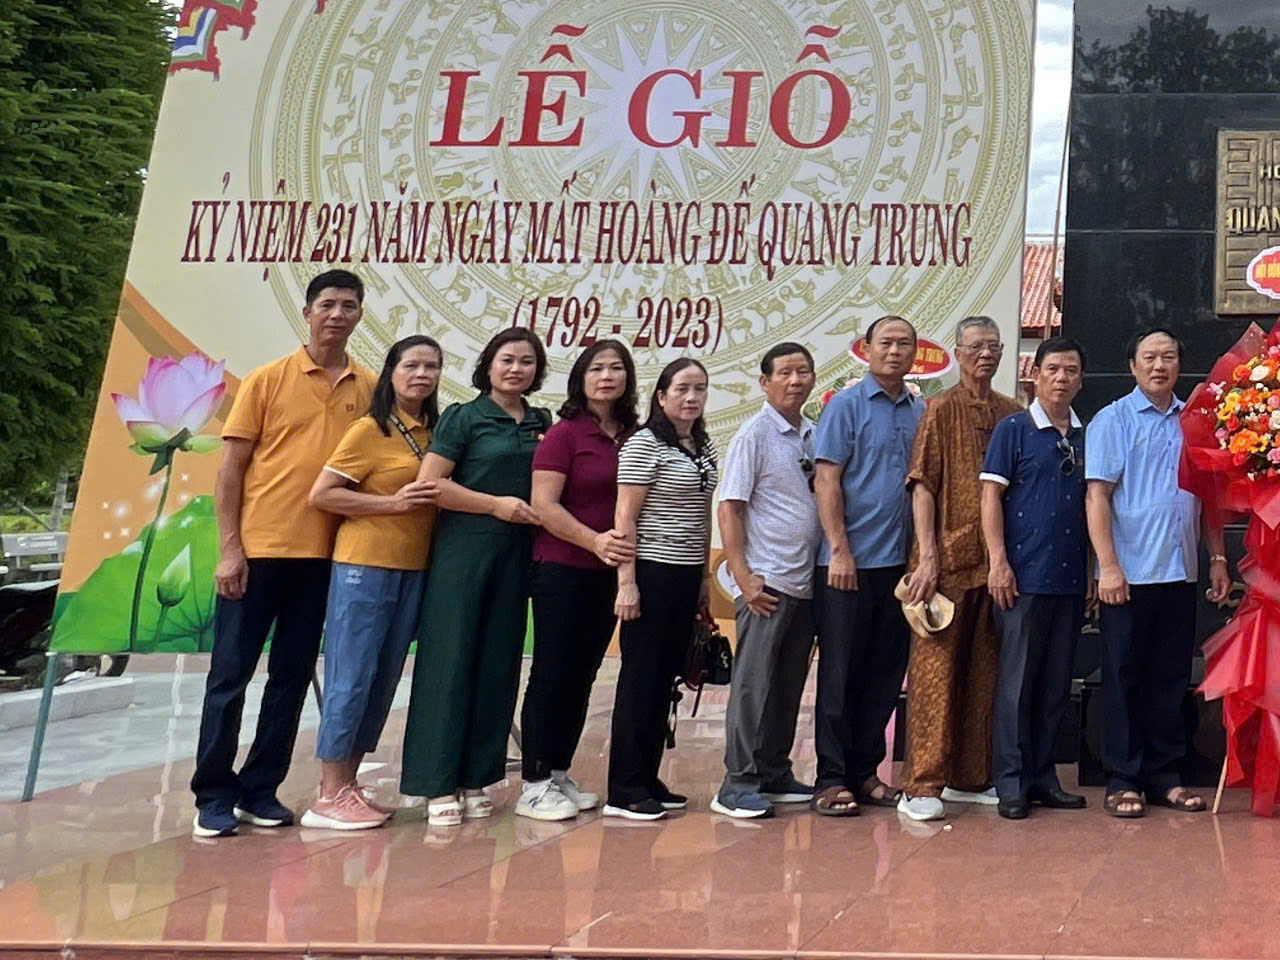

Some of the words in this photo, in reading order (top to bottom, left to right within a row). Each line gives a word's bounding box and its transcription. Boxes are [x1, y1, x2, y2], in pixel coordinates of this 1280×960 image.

[430, 24, 589, 148] LỄ
[628, 25, 852, 150] GIỖ
[180, 172, 231, 262] KỶ
[226, 179, 312, 281] NIỆM
[310, 203, 358, 263] 231
[361, 181, 434, 264] NĂM
[434, 179, 522, 265] NGÀY
[522, 170, 591, 263] MẤT
[593, 179, 701, 265] HOÀNG
[706, 173, 756, 265] ĐẾ
[758, 201, 861, 281] QUANG
[870, 202, 973, 267] TRUNG
[513, 295, 600, 348] (1792
[633, 296, 723, 355] 2023)
